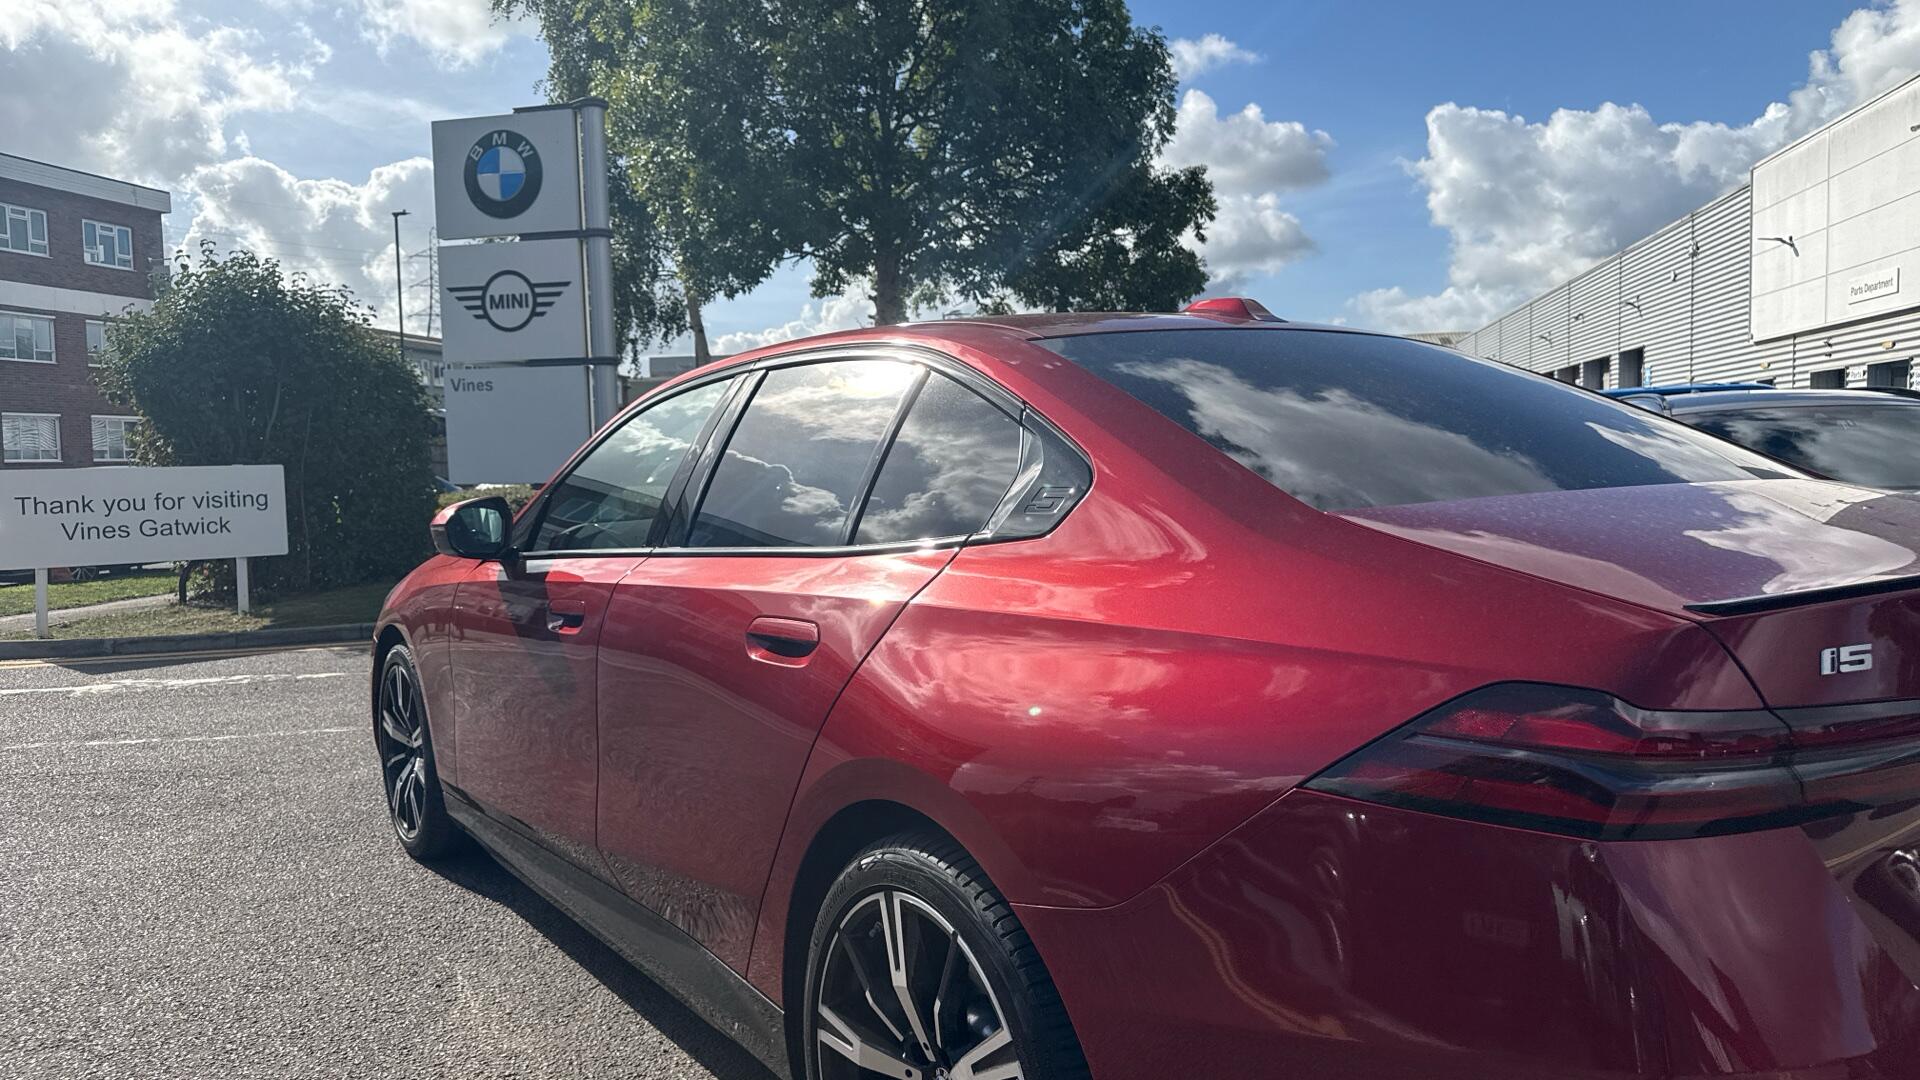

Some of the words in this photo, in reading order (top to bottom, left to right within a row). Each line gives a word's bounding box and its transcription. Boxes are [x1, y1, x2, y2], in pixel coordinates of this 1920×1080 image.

[469, 132, 534, 161] BMW
[1850, 286, 1863, 296] Parts
[1864, 277, 1893, 293] Department
[489, 292, 529, 310] MINI
[450, 378, 494, 392] Vines
[14, 495, 95, 515] Thank
[102, 498, 146, 517] you
[154, 492, 185, 511] for
[192, 490, 269, 511] visiting
[60, 521, 131, 541] Vines
[139, 516, 232, 537] Gatwick
[1820, 643, 1873, 676] i5
